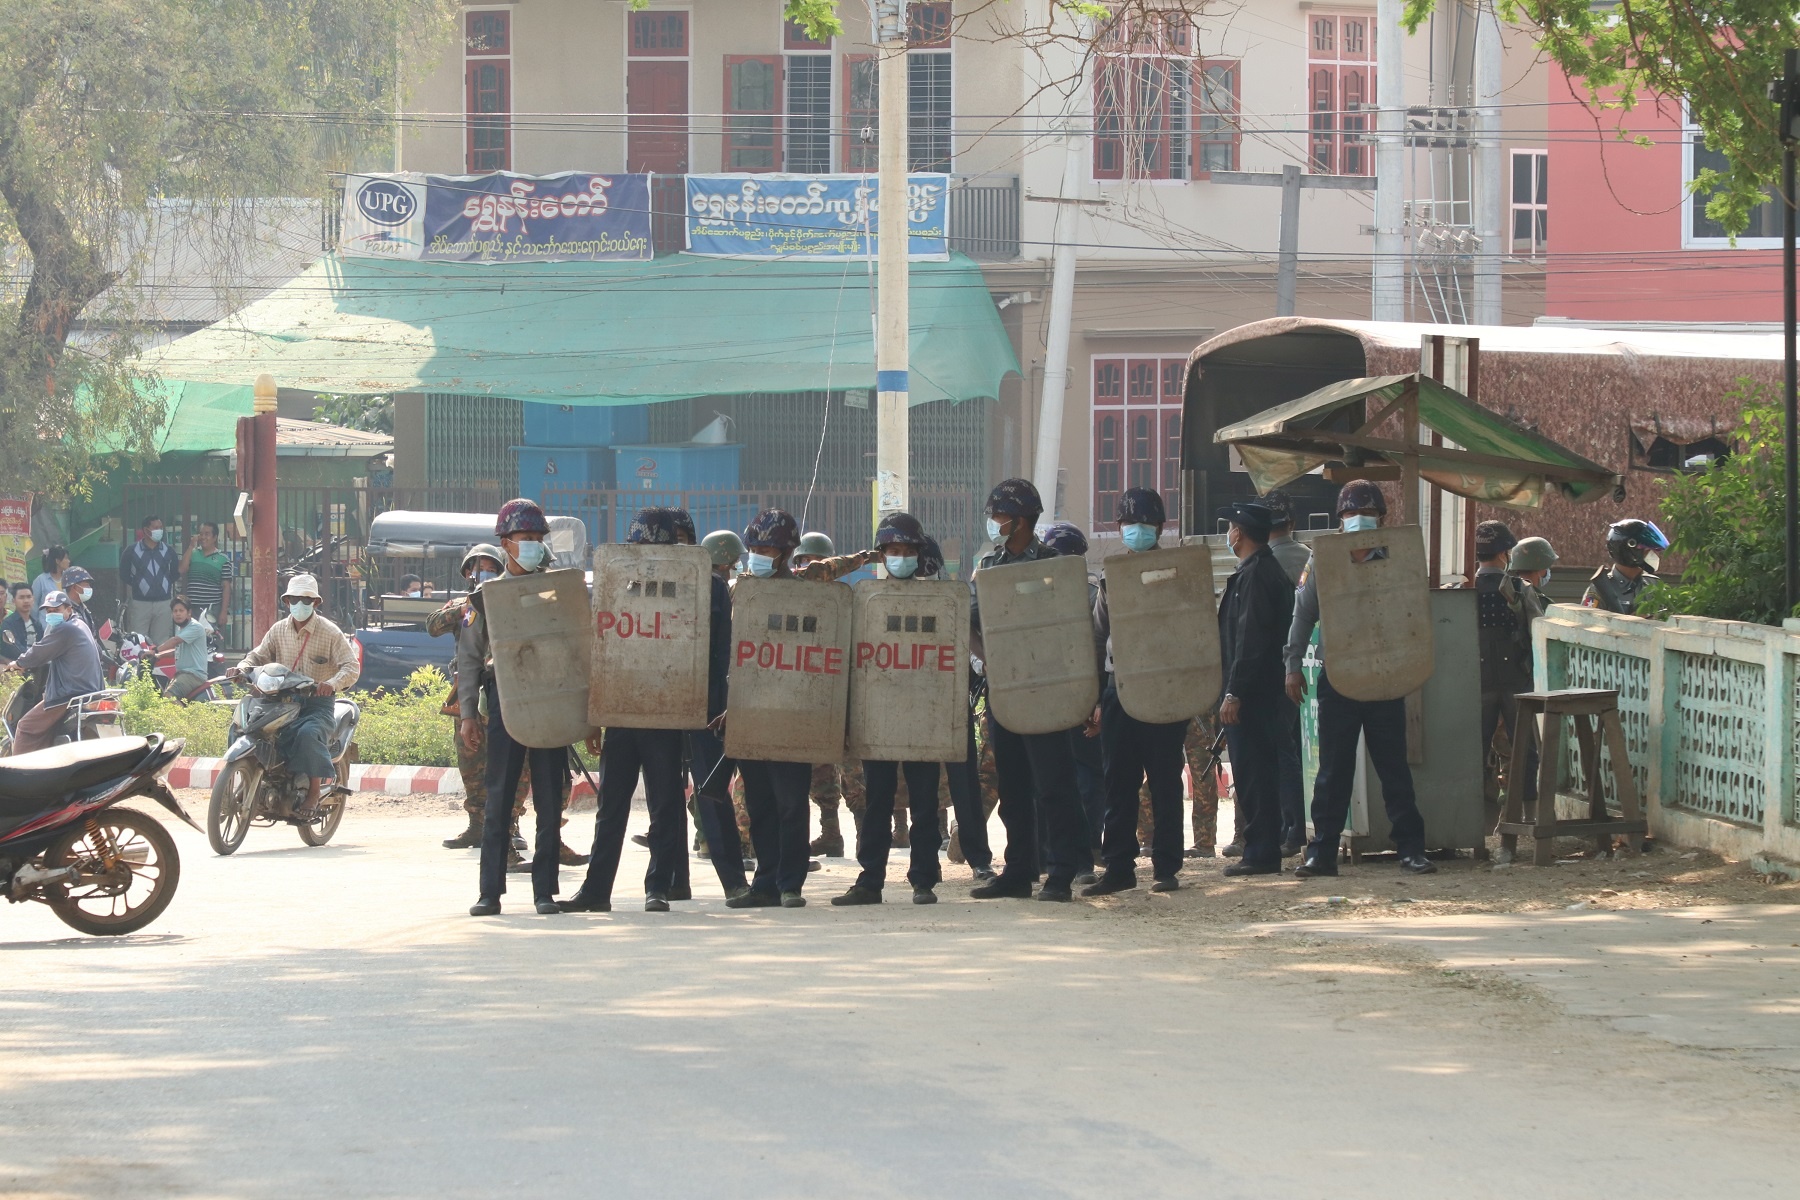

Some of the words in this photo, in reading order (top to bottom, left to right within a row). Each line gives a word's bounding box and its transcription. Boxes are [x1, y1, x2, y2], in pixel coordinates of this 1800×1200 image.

[364, 190, 408, 214] UPG
[364, 240, 402, 254] Paint
[597, 611, 699, 639] POLI
[736, 641, 843, 674] POLICE
